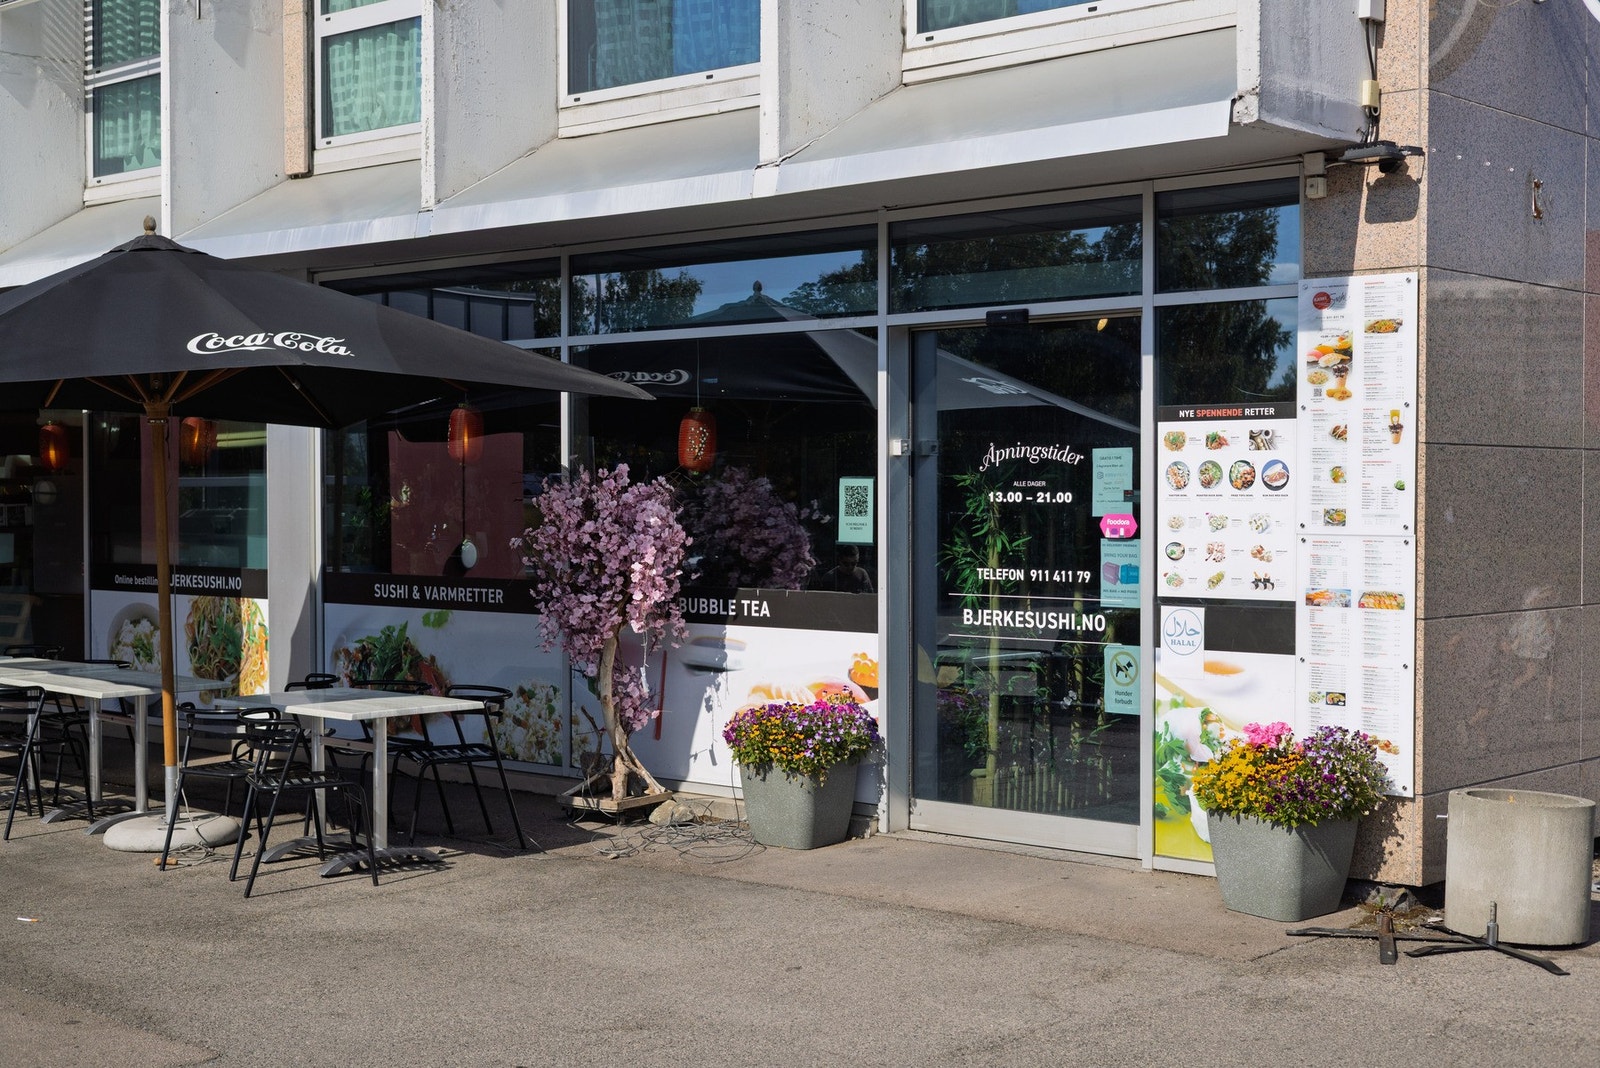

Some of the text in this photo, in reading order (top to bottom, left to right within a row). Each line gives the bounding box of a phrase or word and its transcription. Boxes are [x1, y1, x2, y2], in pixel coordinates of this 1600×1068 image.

[187, 331, 355, 356] Coca-Cola
[1179, 407, 1275, 418] NYE SPENNENDE RETTER
[979, 442, 1085, 472] Åpningstider
[988, 491, 1023, 503] 13.00
[1036, 491, 1073, 503] 21.00
[1106, 518, 1130, 526] foodora
[114, 574, 242, 590] Online bestillin JERKESUSHI.NO
[977, 568, 1091, 583] TELEFON 911 411 79
[374, 583, 504, 604] SUSHI & VARMRETTER
[680, 597, 771, 618] BUBBLE TEA
[963, 608, 1106, 632] BJERKESUSHI.NO
[1170, 639, 1197, 647] HALAL
